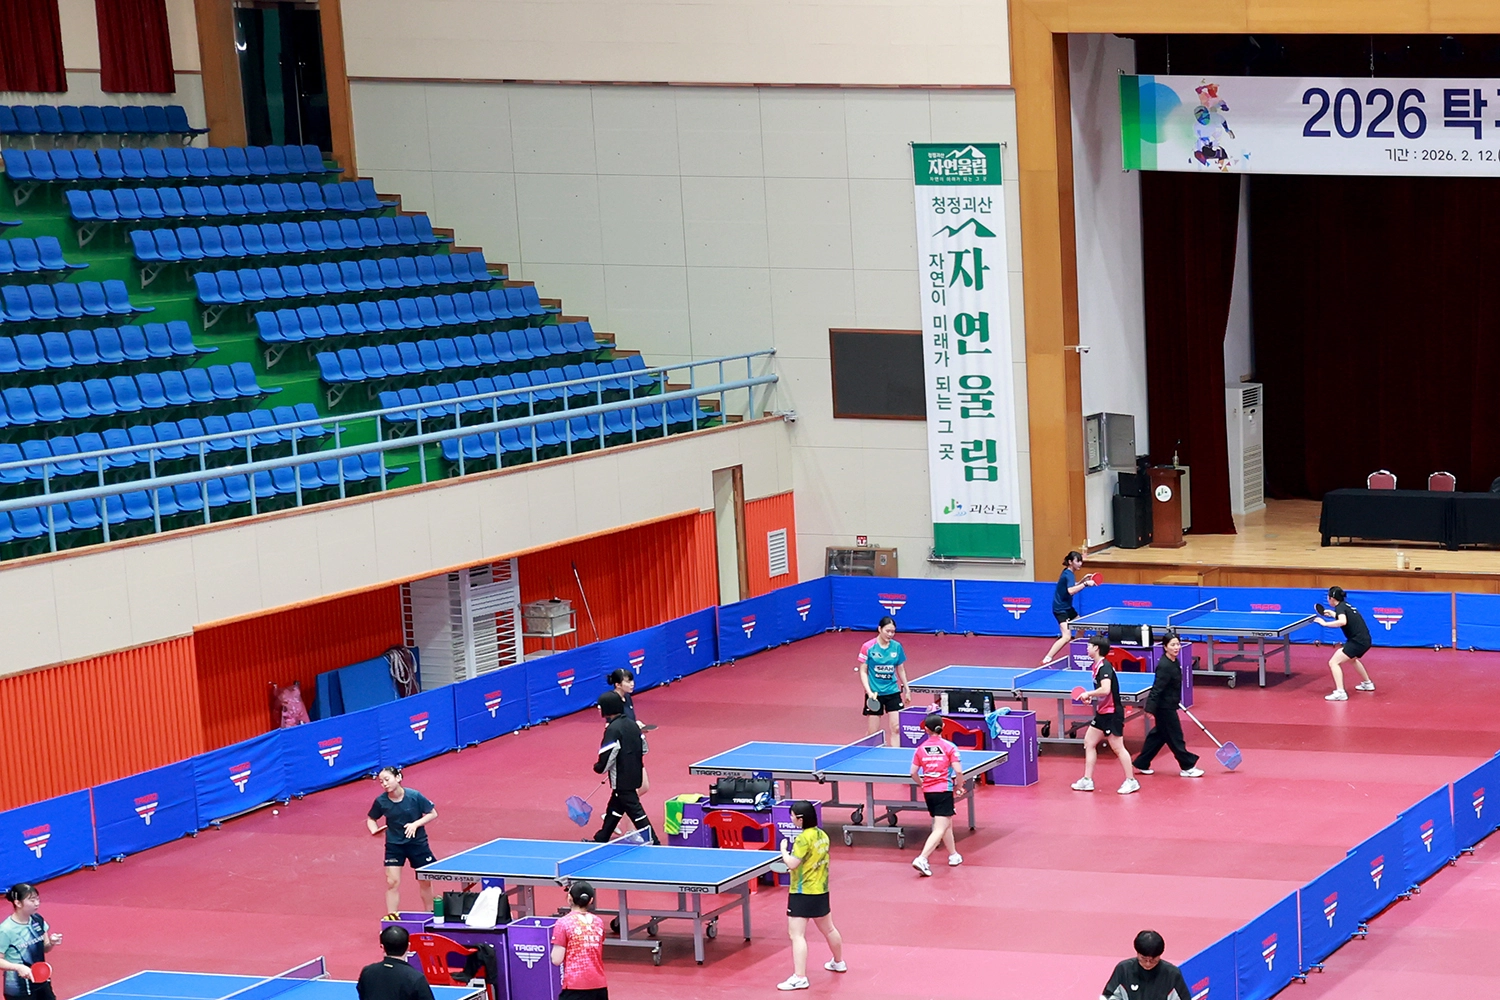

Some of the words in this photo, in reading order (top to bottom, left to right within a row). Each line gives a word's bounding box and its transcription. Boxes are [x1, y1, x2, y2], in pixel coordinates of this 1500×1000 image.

[1302, 87, 1427, 139] 2026
[1384, 148, 1409, 162] 기간
[1421, 149, 1457, 162] 2026.
[1461, 150, 1473, 162] 2.
[928, 158, 987, 176] 자연울림
[931, 196, 993, 214] 청정괴산
[928, 252, 947, 307] 자연이
[932, 314, 950, 368] 미래가
[948, 246, 999, 483] 자연울림
[935, 375, 952, 411] 되는
[938, 420, 954, 434] 그
[938, 443, 955, 461] 곳
[969, 504, 1009, 516] 괴산군
[513, 943, 545, 952] TAGRO
